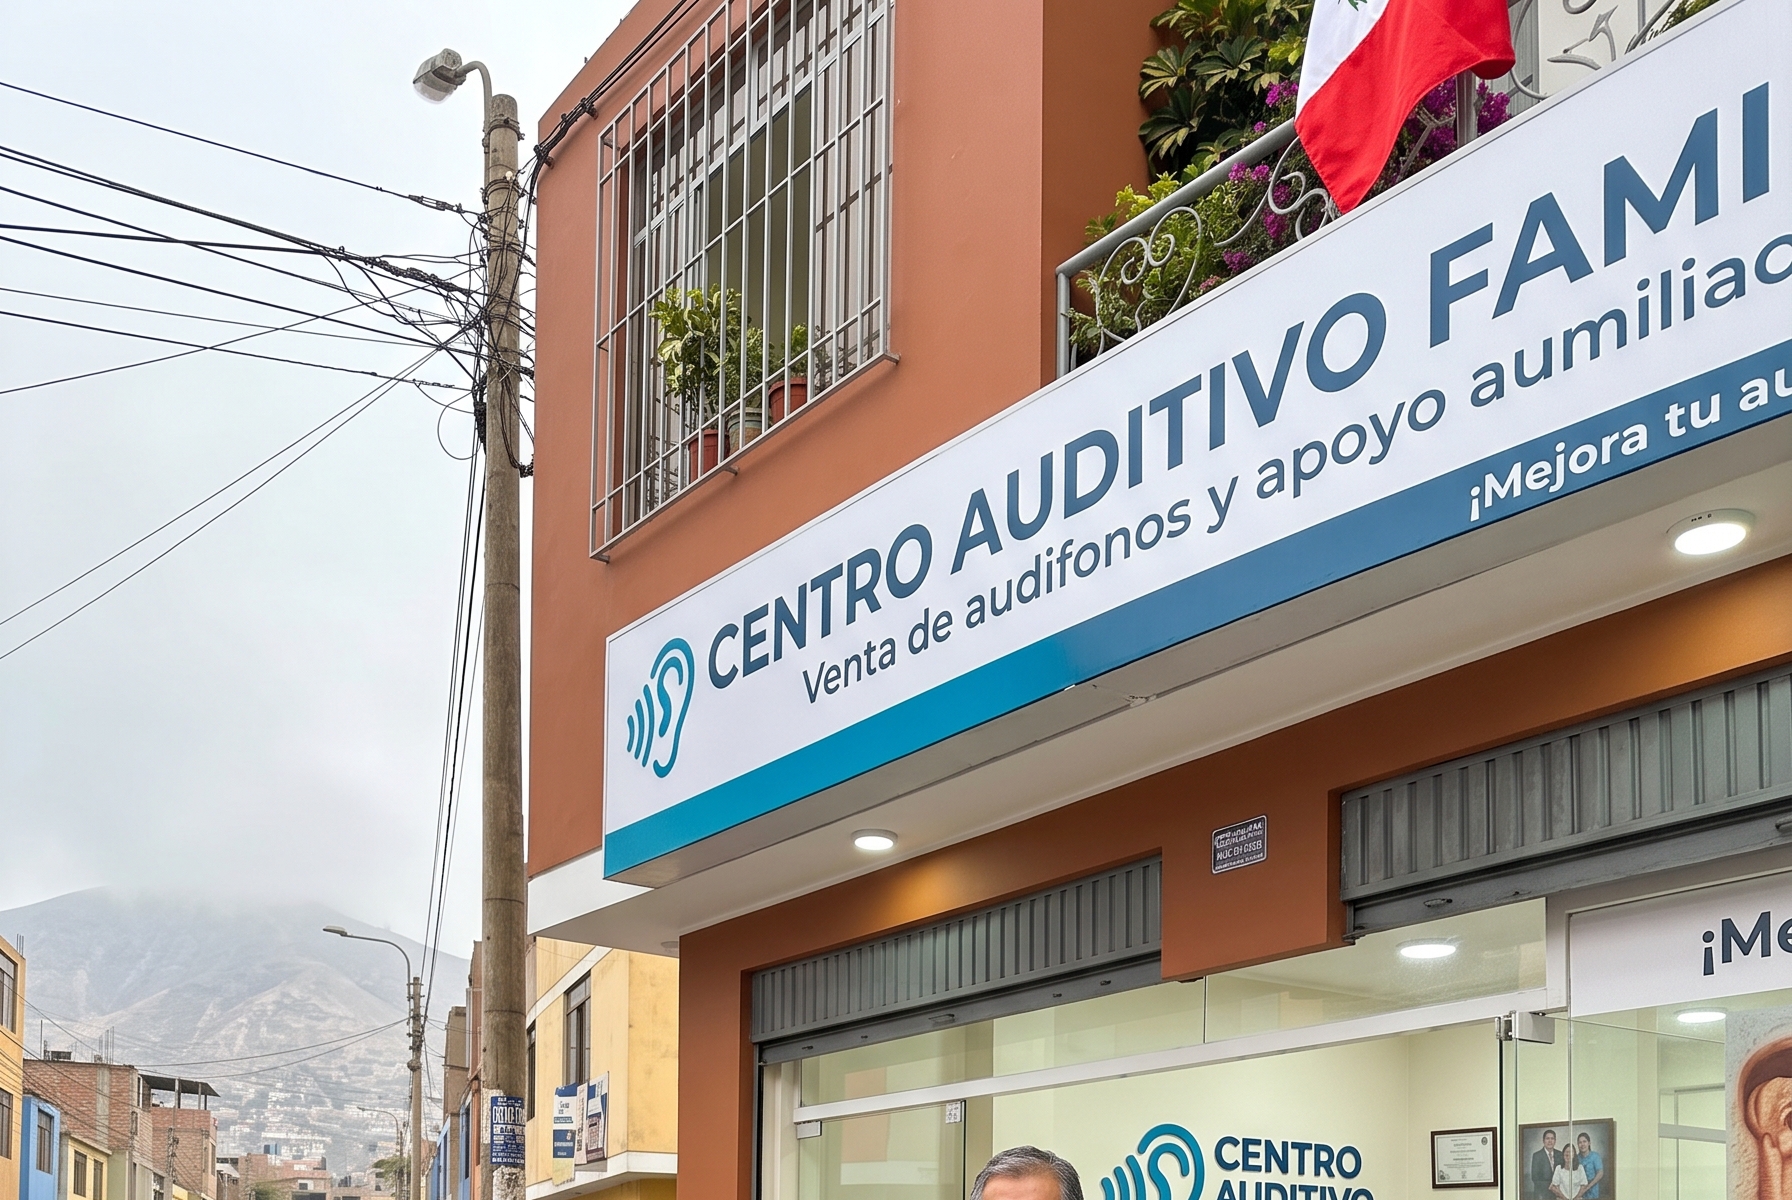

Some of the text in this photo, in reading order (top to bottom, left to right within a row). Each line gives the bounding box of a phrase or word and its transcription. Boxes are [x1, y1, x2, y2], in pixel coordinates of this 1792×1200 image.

[708, 81, 1771, 690] CENTRO AUDITIVO FAMI
[1468, 422, 1648, 522] ¡Mejora
[1664, 392, 1721, 438] tu
[802, 634, 896, 704] Venta
[907, 607, 953, 654] de
[966, 498, 1192, 630] audifonos
[1206, 475, 1239, 533] y
[1256, 388, 1446, 500] apoyo
[1214, 1136, 1362, 1180] CENTRO
